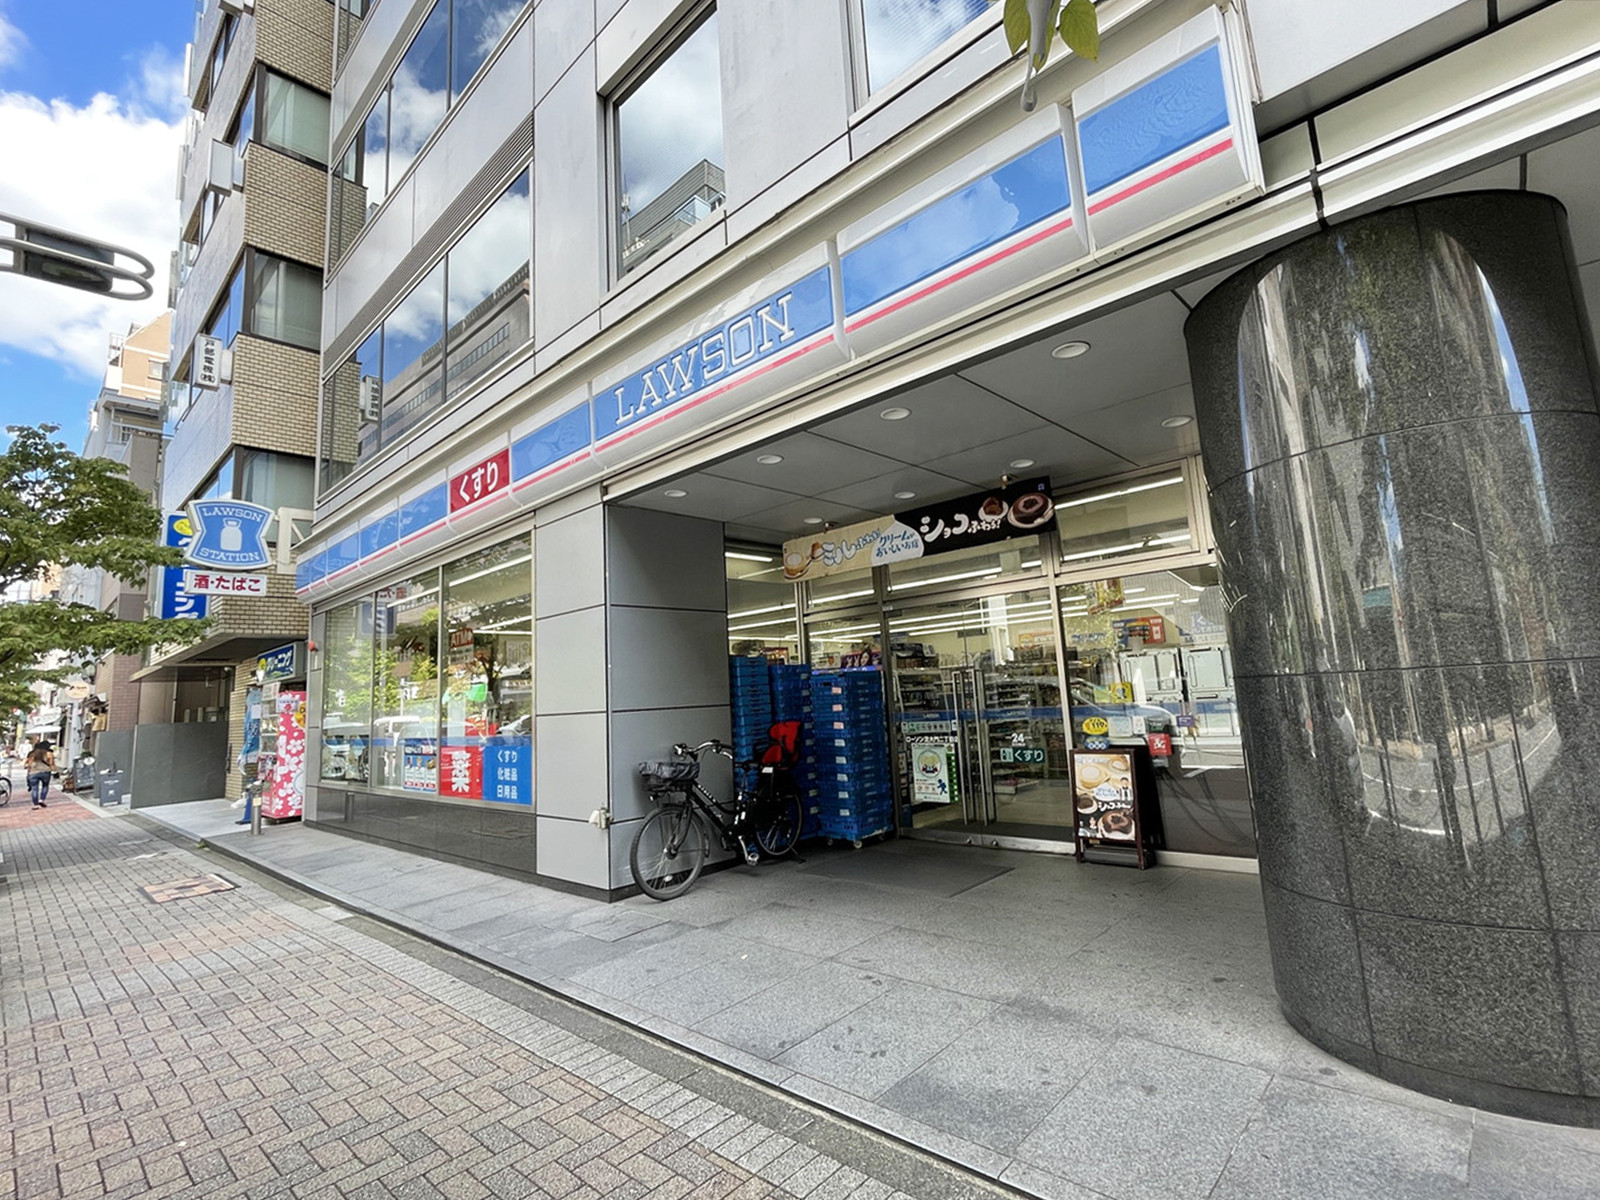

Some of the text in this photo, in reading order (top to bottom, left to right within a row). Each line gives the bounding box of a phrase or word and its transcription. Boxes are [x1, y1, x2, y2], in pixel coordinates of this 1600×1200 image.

[614, 292, 795, 425] LAWSON
[458, 461, 499, 502] くすり
[202, 507, 263, 522] LAWSON
[200, 547, 260, 561] STATION
[194, 574, 260, 592] 酒・たばこ
[1011, 733, 1025, 743] 24
[497, 749, 518, 763] くすり
[1014, 749, 1044, 762] くすり
[496, 767, 518, 782] 化粧品
[496, 784, 518, 799] 日用品
